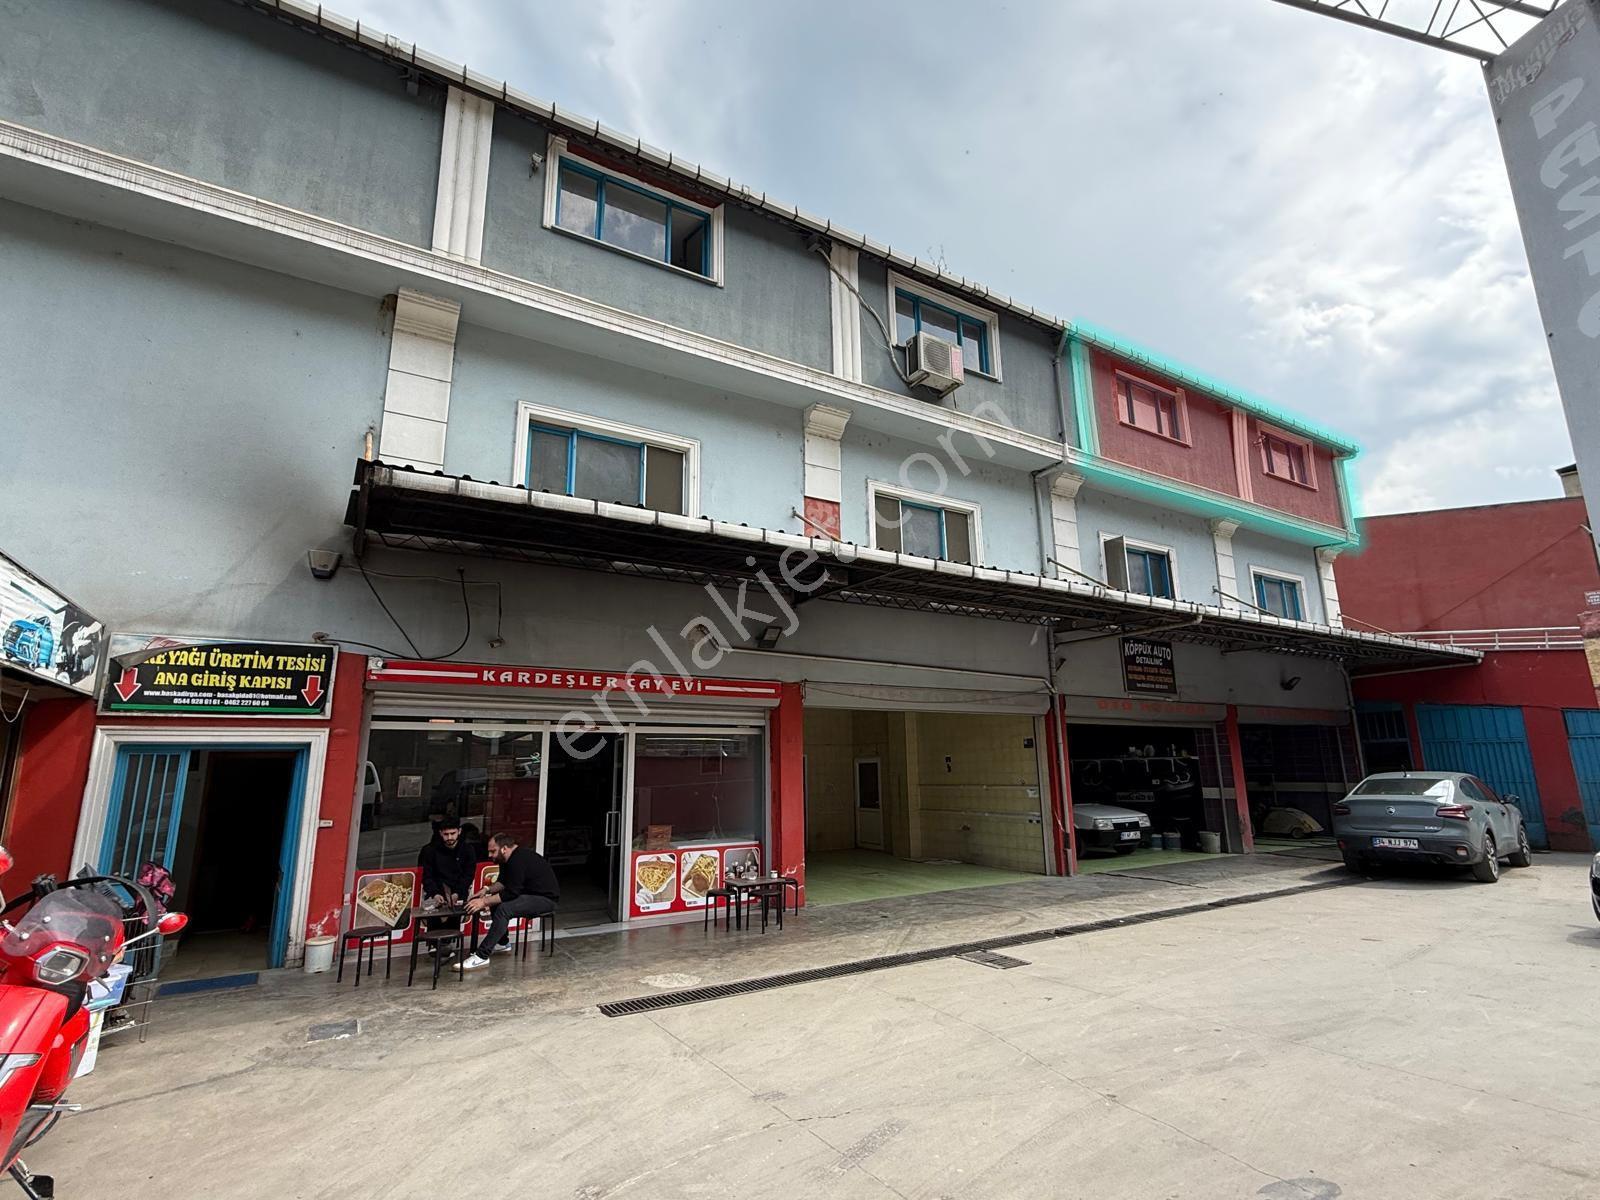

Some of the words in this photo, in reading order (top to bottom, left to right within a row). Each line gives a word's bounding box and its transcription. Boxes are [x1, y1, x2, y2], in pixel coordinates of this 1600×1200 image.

[168, 648, 206, 666] YAĞI
[209, 648, 274, 669] ÜRETİM
[276, 653, 326, 672] TESİSİ
[1153, 645, 1171, 660] AUTO
[153, 671, 188, 686] ANA
[191, 670, 237, 691] GİRİŞ
[239, 675, 293, 690] KAPISI
[482, 669, 618, 688] KARDEŞLER
[627, 678, 663, 692] ÇAY
[672, 680, 702, 692] EVİ
